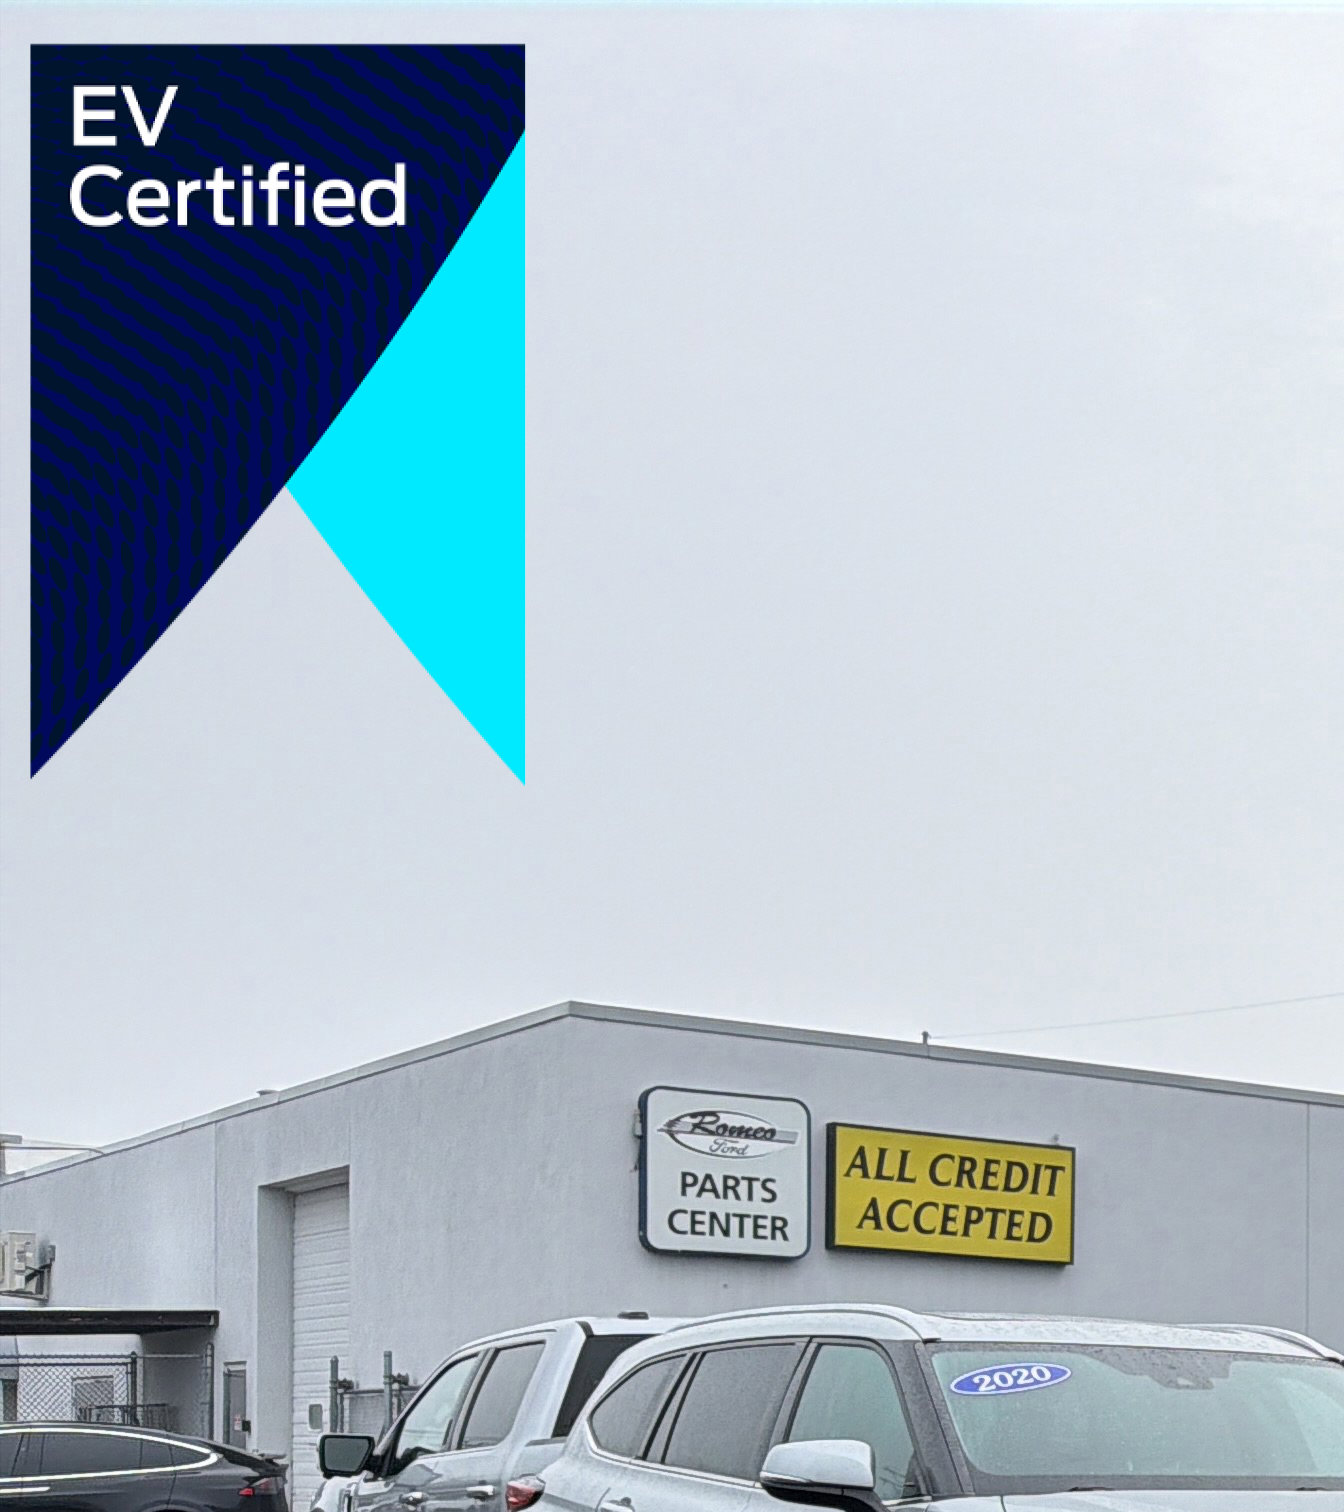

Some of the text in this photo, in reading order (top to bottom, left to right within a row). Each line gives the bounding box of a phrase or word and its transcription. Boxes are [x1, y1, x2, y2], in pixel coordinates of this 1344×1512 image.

[688, 1110, 777, 1140] Romeo
[708, 1138, 750, 1156] Ford
[680, 1171, 778, 1204] PARTS
[844, 1147, 1066, 1197] ALL CREDIT
[667, 1208, 790, 1242] CENTER
[855, 1197, 1053, 1244] ACCEPTED
[972, 1365, 1052, 1392] 2020
